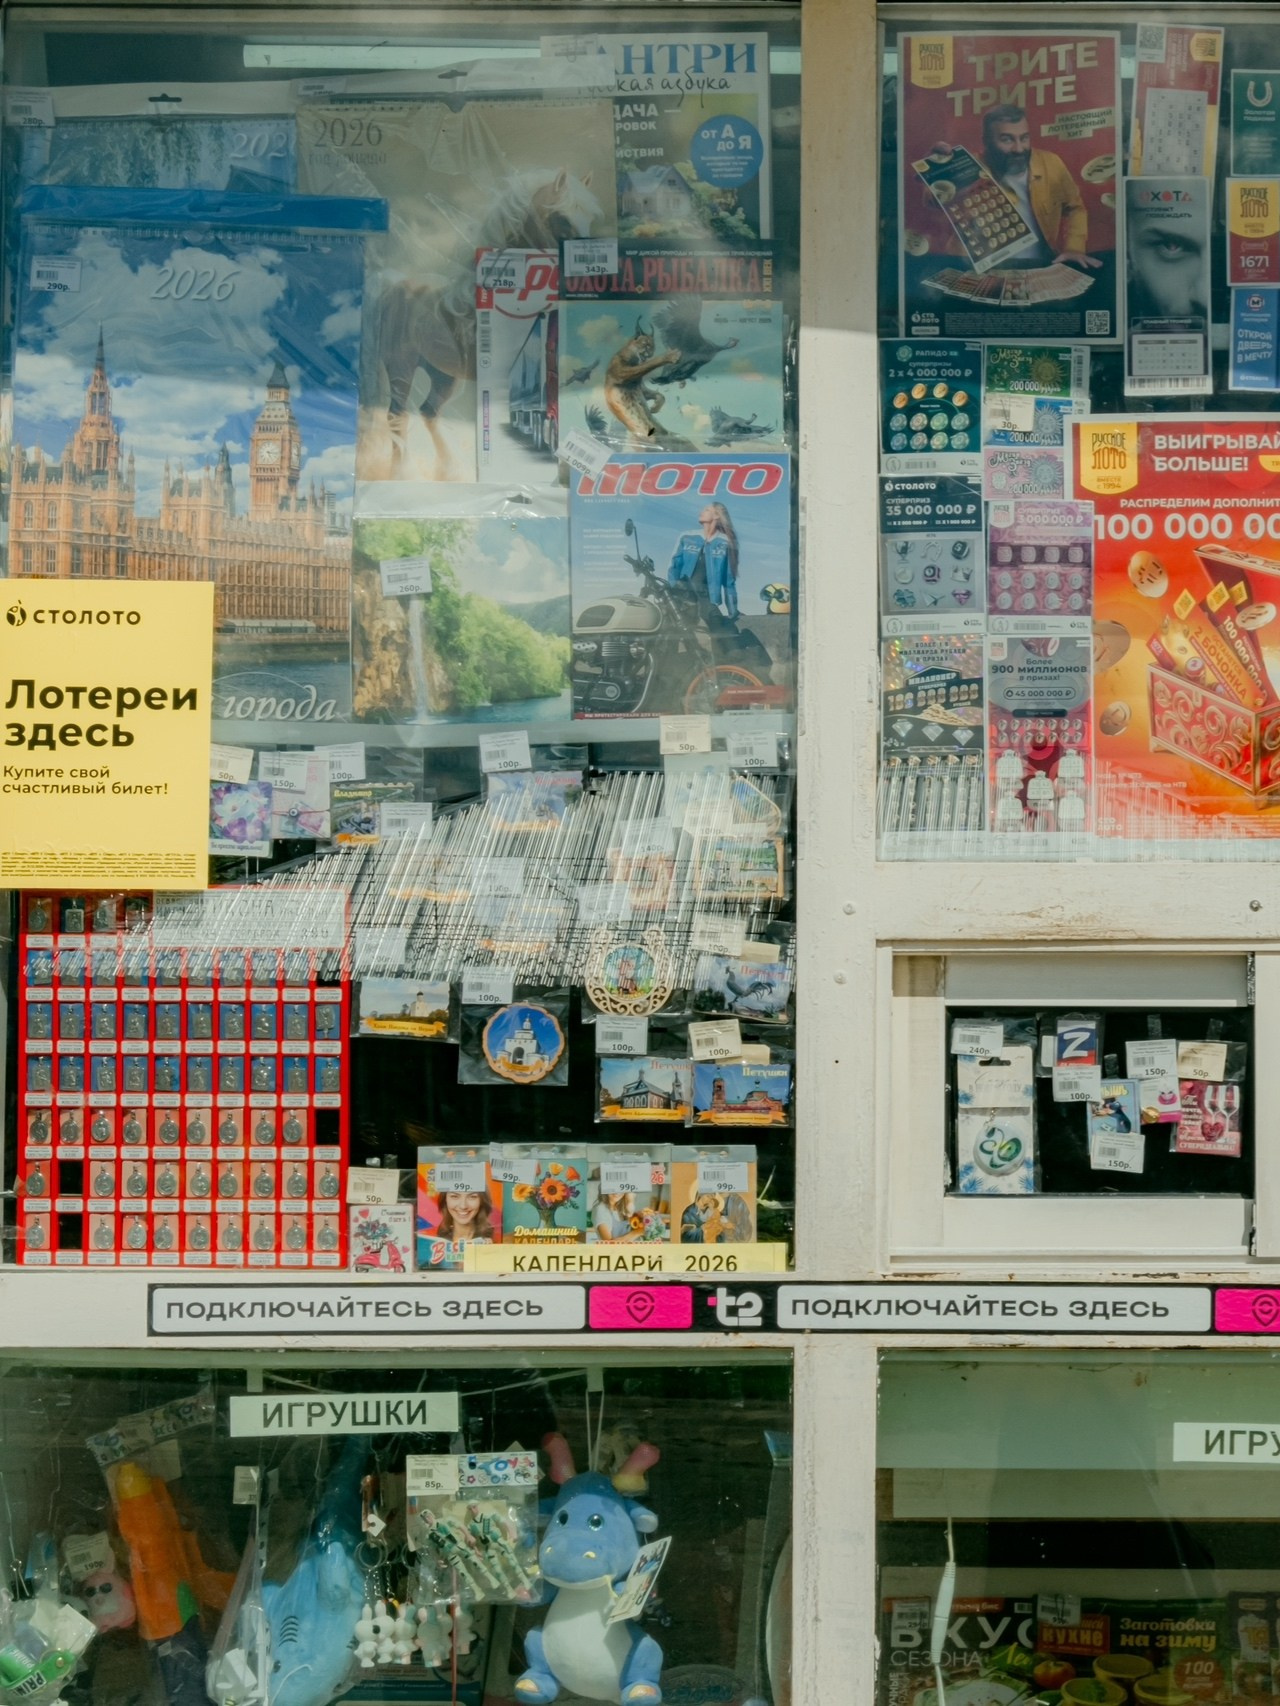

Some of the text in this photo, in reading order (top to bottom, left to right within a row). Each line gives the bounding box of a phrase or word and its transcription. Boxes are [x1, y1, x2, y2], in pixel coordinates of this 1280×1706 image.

[967, 41, 1098, 82] ТРИТЕ
[946, 75, 1077, 117] ТРИТЕ
[314, 118, 383, 148] 2026
[739, 136, 751, 149] Я
[1240, 256, 1269, 268] 1671
[585, 265, 608, 274] 343р.
[643, 258, 763, 293] РЫБАЛКА
[47, 282, 70, 291] 290р.
[151, 267, 241, 301] 2026
[1002, 422, 1019, 430] 30р.
[1092, 433, 1126, 450] РУССКОЕ
[1091, 449, 1127, 470] ЛОТО
[1155, 457, 1248, 472] БОЛЬШЕ!
[894, 482, 936, 490] СТОЛОТО
[1120, 498, 1211, 509] РАСПРЕДЕЛИМ
[1094, 514, 1153, 540] 100
[1164, 513, 1232, 539] 000
[33, 610, 141, 625] СТОЛОТО
[992, 666, 1088, 674] 900 миллионов
[1202, 636, 1247, 700] БОЧОНКА
[5, 680, 198, 717] Лотереи
[223, 685, 337, 722] города
[4, 723, 135, 750] здесь
[498, 760, 523, 769] 100р.
[3, 766, 110, 780] Купите свой
[2, 782, 168, 795] счастливый билет!
[274, 780, 297, 790] 150р.
[478, 994, 504, 1003] 100р.
[612, 1044, 635, 1053] 100р.
[969, 1047, 991, 1055] 240р.
[1062, 1031, 1091, 1059] Z
[709, 1048, 732, 1057] 100р.
[742, 1066, 788, 1078] Петушки
[1145, 1068, 1168, 1077] 150р.
[1193, 1069, 1211, 1078] 50р.
[1070, 1093, 1093, 1101] 100р.
[1108, 1160, 1131, 1170] 150р.
[503, 1173, 521, 1183] 99р.
[454, 1183, 472, 1192] 99р.
[620, 1183, 638, 1192] 99р.
[716, 1183, 736, 1192] 99р.
[366, 1195, 384, 1204] 50р.
[514, 1225, 578, 1236] Домашний
[513, 1254, 737, 1272] КАЛЕНДАРИ 2026
[166, 1286, 544, 1319] ПОДКЛЮЧАЙТЕСЬ ЗДЕСЬ
[792, 1287, 1169, 1320] ПОДКЛЮЧАЙТЕСЬ ЗДЕСЬ
[262, 1400, 428, 1428] ИГРУШКИ
[425, 1481, 443, 1490] 85р.
[1120, 1618, 1216, 1632] Заготовки
[1120, 1633, 1216, 1651] на зиму
[891, 1651, 982, 1667] СЕЗОНА
